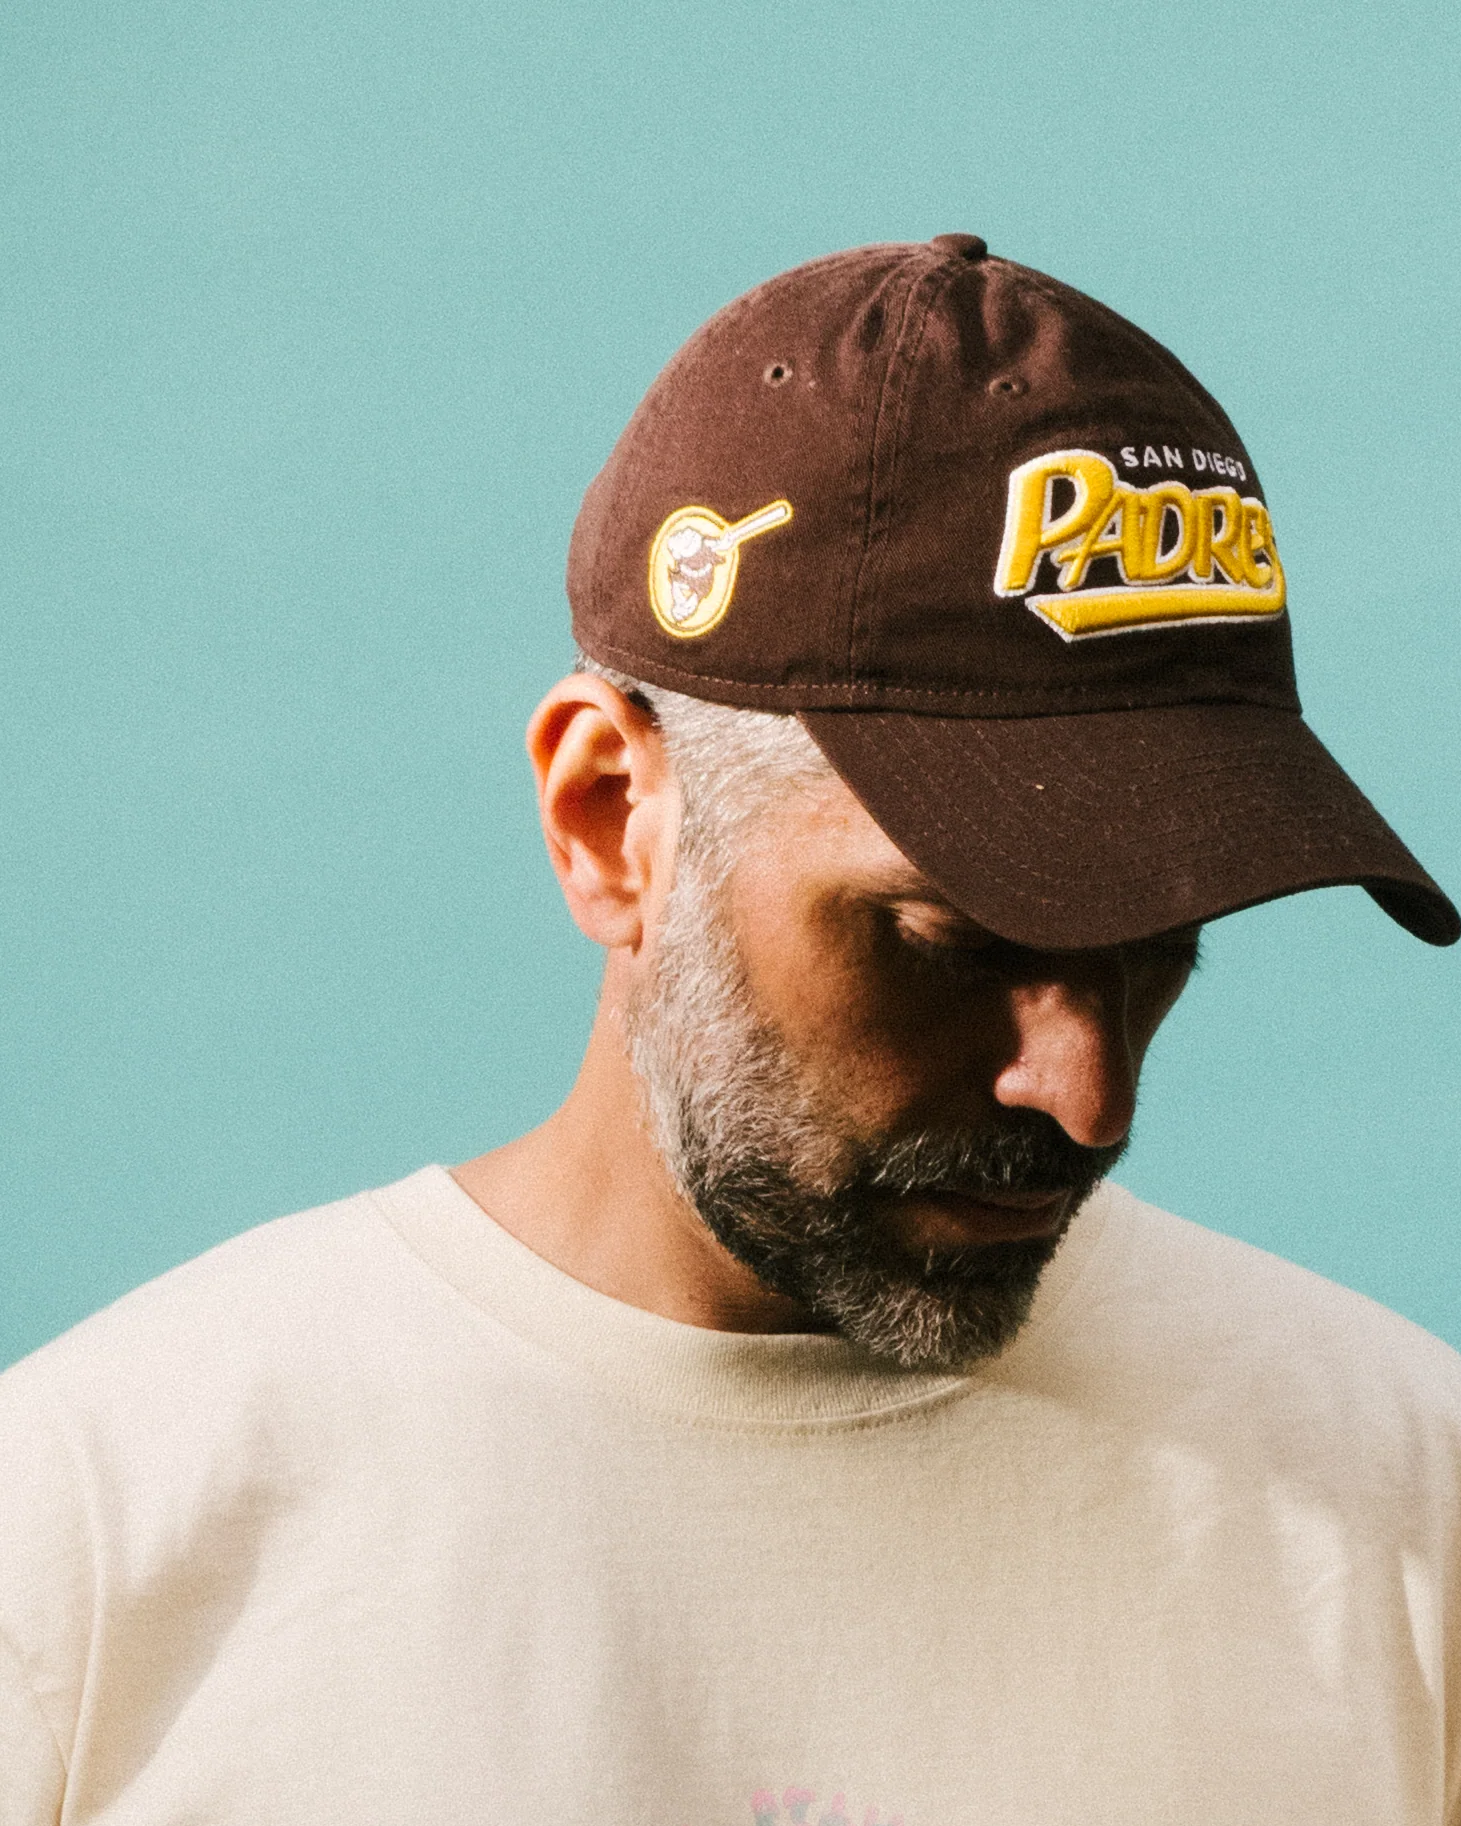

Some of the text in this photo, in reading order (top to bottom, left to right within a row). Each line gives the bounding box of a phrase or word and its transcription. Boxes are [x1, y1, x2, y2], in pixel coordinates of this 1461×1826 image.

[1120, 445, 1247, 482] SAN DIEGO
[994, 449, 1276, 597] PADRE
